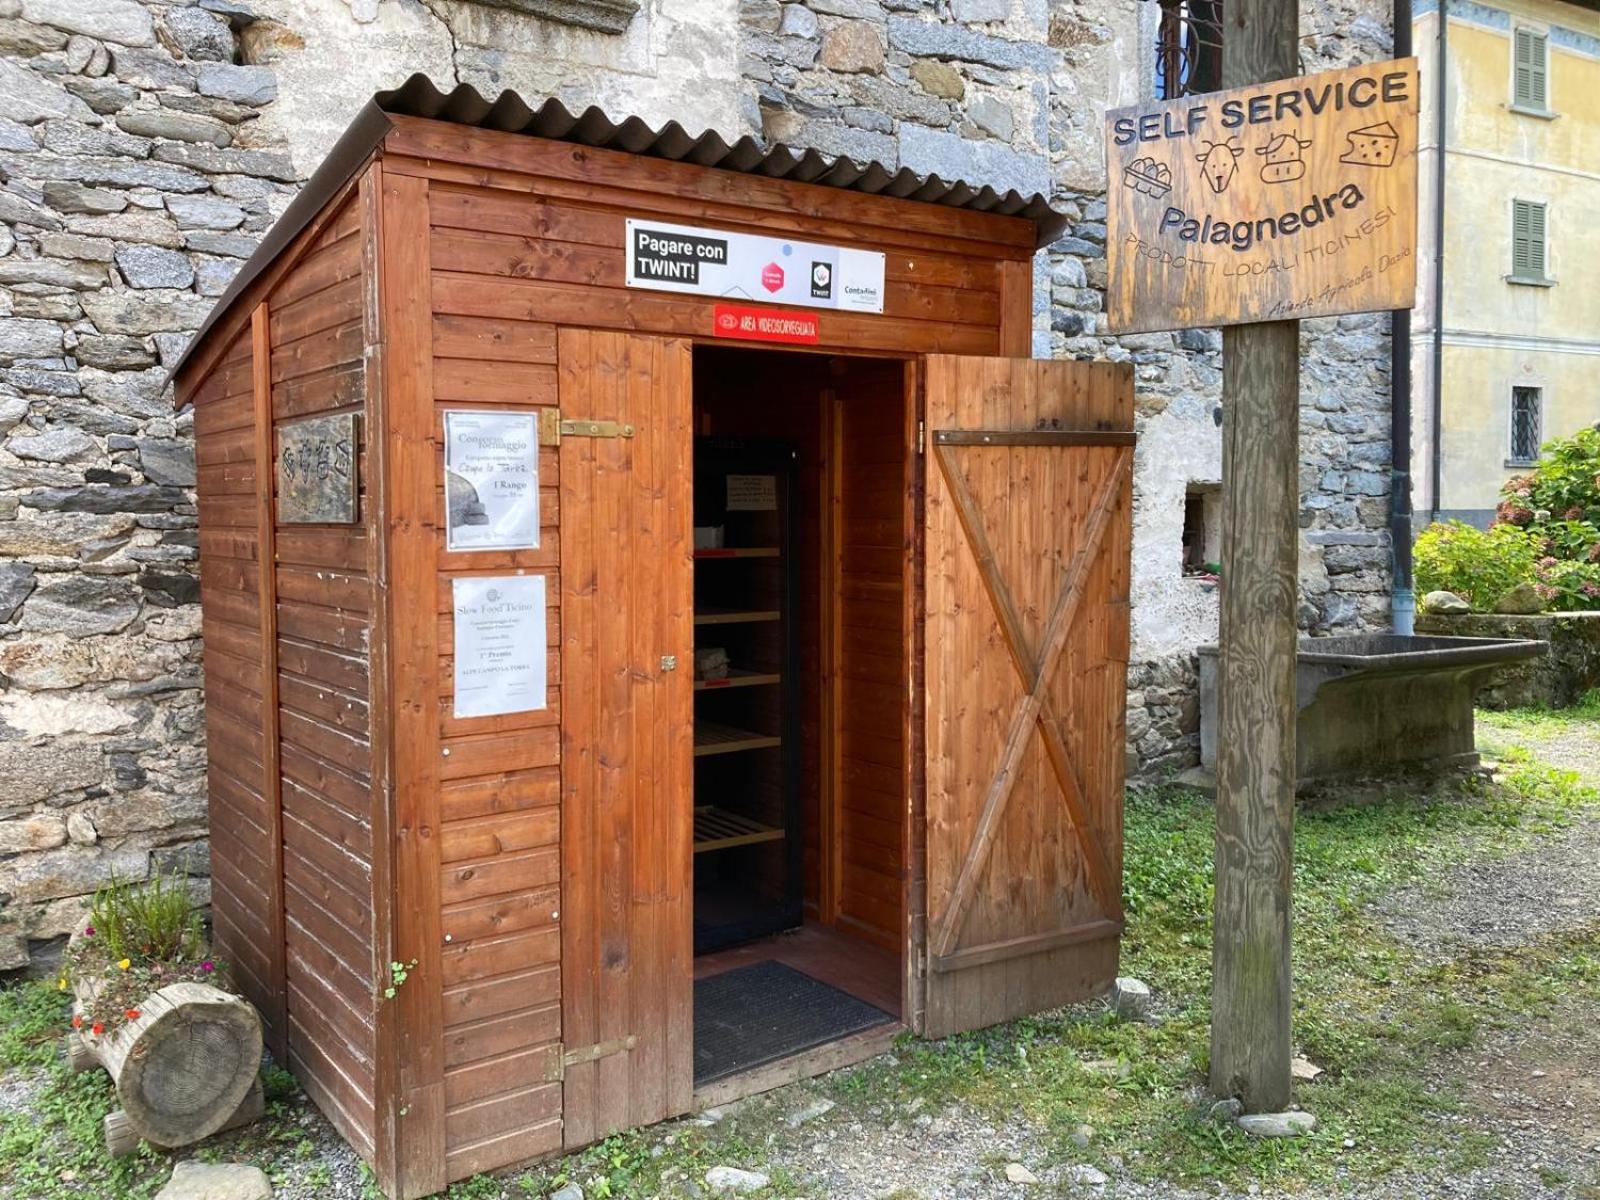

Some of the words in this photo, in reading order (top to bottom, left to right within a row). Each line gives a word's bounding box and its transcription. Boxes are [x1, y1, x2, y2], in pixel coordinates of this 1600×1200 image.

[1114, 106, 1208, 146] SELF
[1221, 71, 1409, 128] SERVICE
[1159, 183, 1365, 250] Palagnedra
[638, 232, 693, 257] Pagare
[697, 245, 724, 260] con
[1126, 232, 1216, 275] PRODOTTI
[1223, 255, 1299, 276] LOCALI
[1304, 206, 1397, 262] TICINESI
[638, 257, 696, 279] TWINT!
[812, 289, 830, 297] TWINT
[1268, 297, 1314, 318] Azienda
[1318, 265, 1374, 303] Agricola
[740, 315, 757, 331] AREA
[758, 317, 816, 337] VIDEOSORVEGLIATA
[500, 480, 527, 492] Rango
[457, 605, 477, 615] Slow
[480, 603, 504, 614] Food
[506, 602, 532, 612] Ticino
